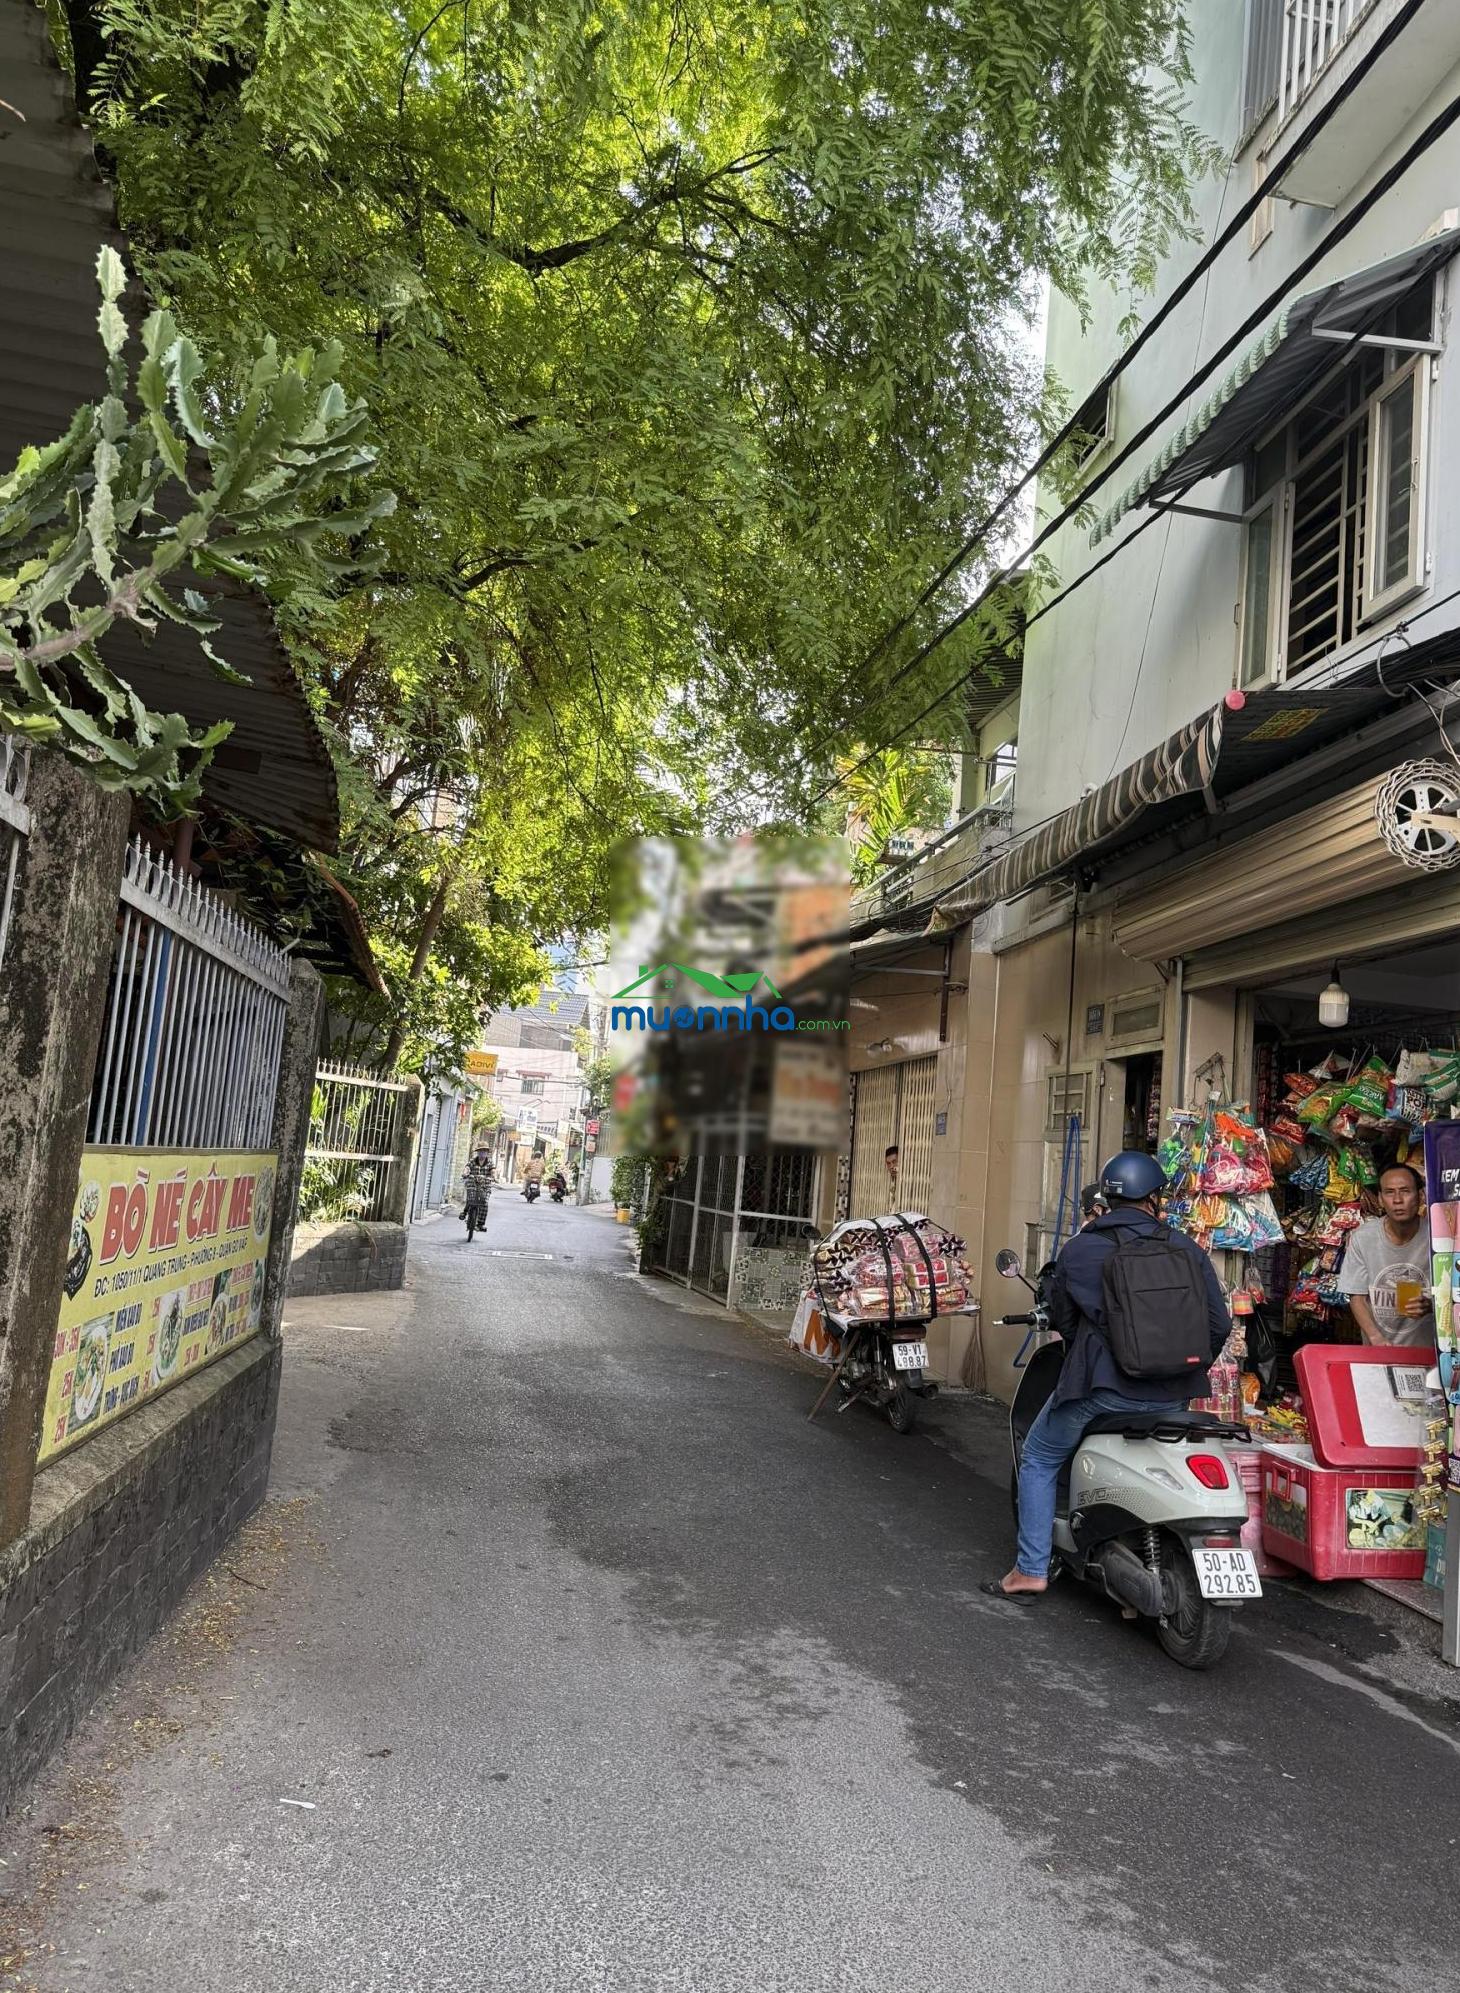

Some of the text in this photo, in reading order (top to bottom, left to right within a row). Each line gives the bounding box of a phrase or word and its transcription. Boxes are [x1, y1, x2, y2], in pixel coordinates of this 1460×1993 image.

[100, 1161, 255, 1263] BÒ NÉ CÂY ME
[143, 1259, 167, 1283] QUANG
[167, 1253, 187, 1276] TRUNG
[1373, 1290, 1398, 1308] VIN
[1203, 1553, 1246, 1571] 50-AD
[1204, 1574, 1256, 1594] 292.85
